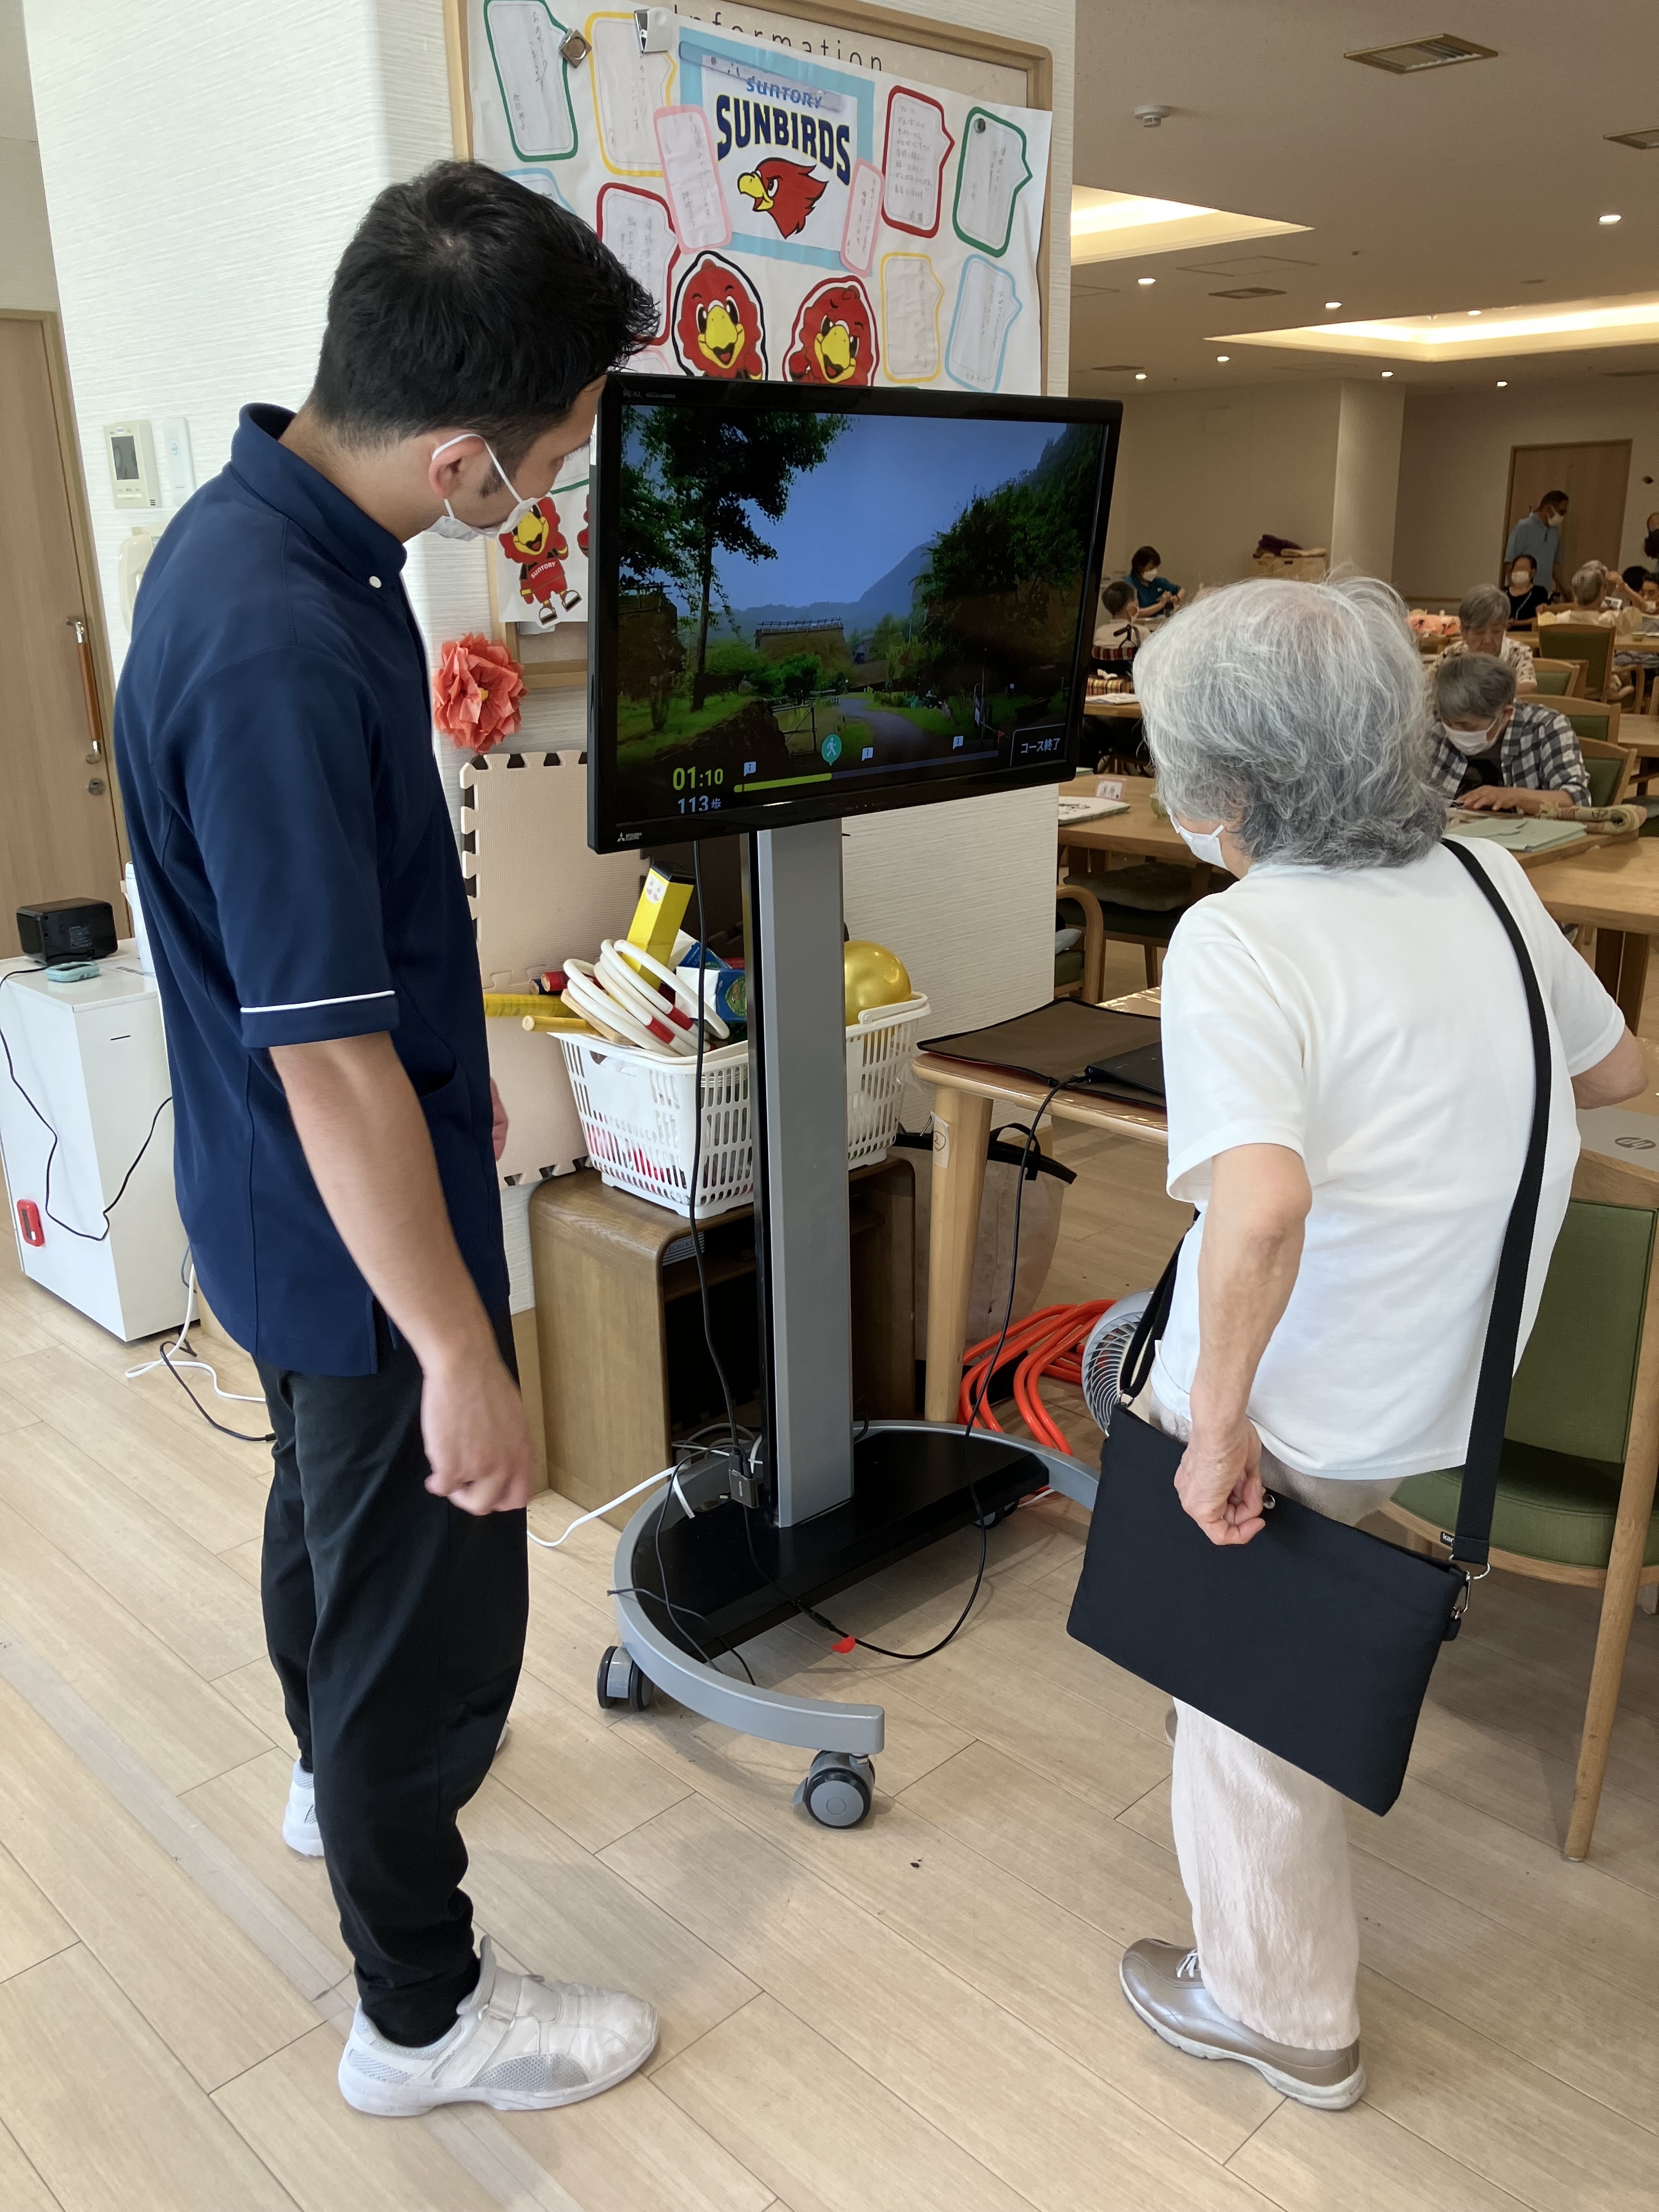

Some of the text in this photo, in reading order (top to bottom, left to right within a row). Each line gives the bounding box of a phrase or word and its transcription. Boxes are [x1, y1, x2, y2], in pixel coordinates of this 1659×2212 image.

[674, 4, 882, 71] frmation
[746, 77, 822, 109] SUNTORY
[716, 94, 850, 186] SUNBIRDS
[531, 561, 556, 579] SUNTORY
[1020, 737, 1061, 754] コース終了
[673, 766, 724, 791] 01:10
[678, 795, 722, 814] 113歩
